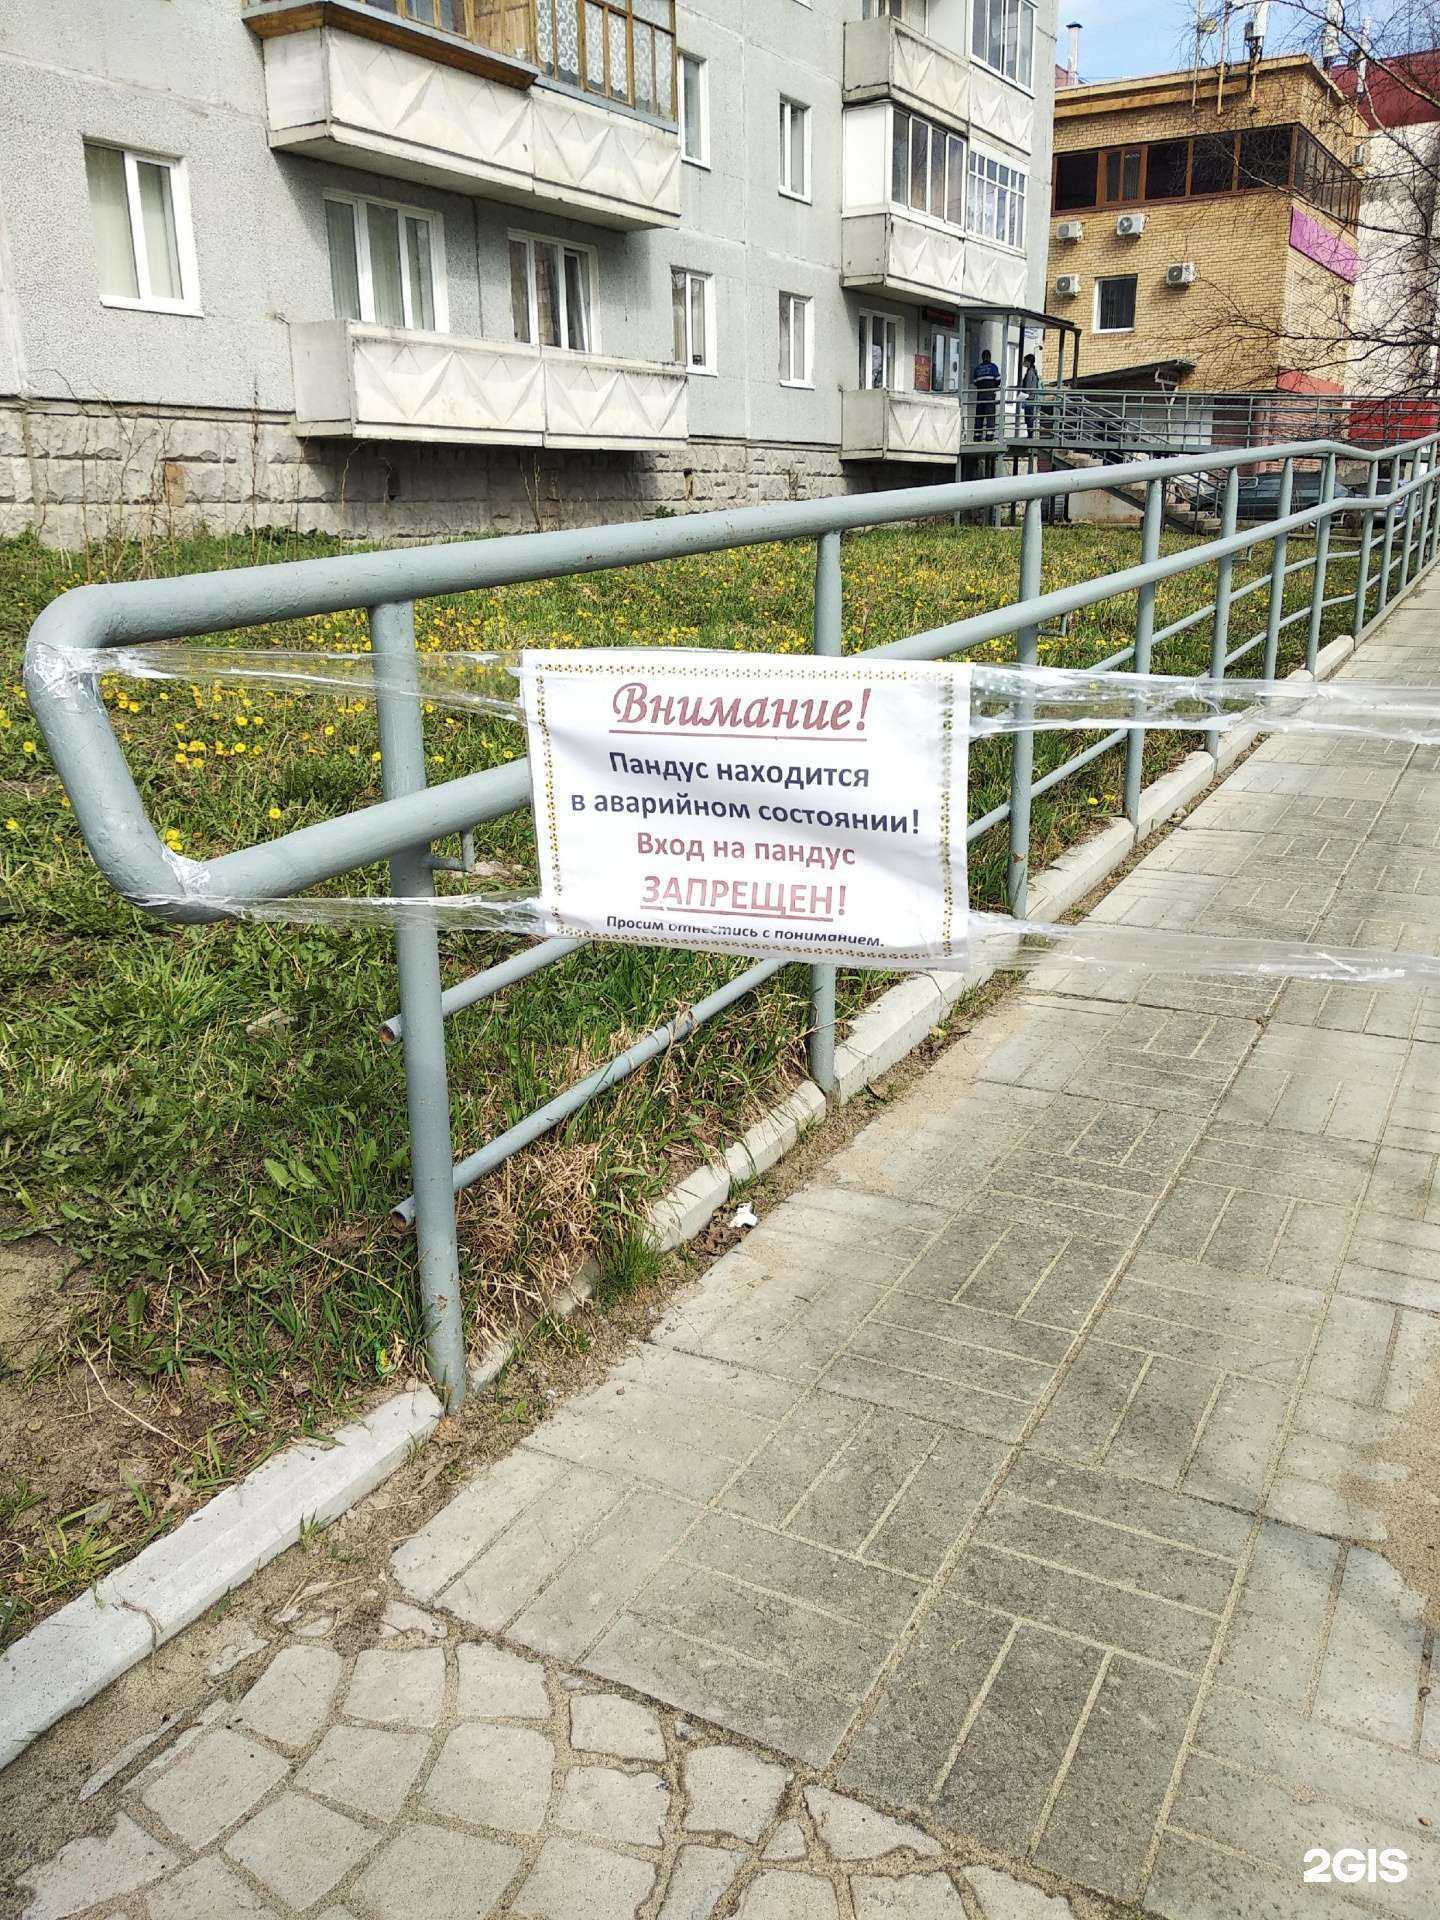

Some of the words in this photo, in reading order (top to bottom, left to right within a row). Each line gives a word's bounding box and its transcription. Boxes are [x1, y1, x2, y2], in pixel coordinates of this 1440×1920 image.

[612, 682, 872, 731] Внимание!
[609, 751, 709, 783] Пандус
[717, 762, 870, 790] находится
[571, 794, 586, 812] в
[594, 792, 751, 820] аварийном
[758, 805, 920, 835] состоянии!
[637, 831, 705, 862] Вход
[713, 840, 746, 859] на
[755, 842, 856, 871] пандус
[641, 875, 847, 915] ЗАПРЕЩЕН!
[606, 915, 664, 931] Просим
[762, 927, 771, 939] с
[774, 930, 885, 948] пониманием.
